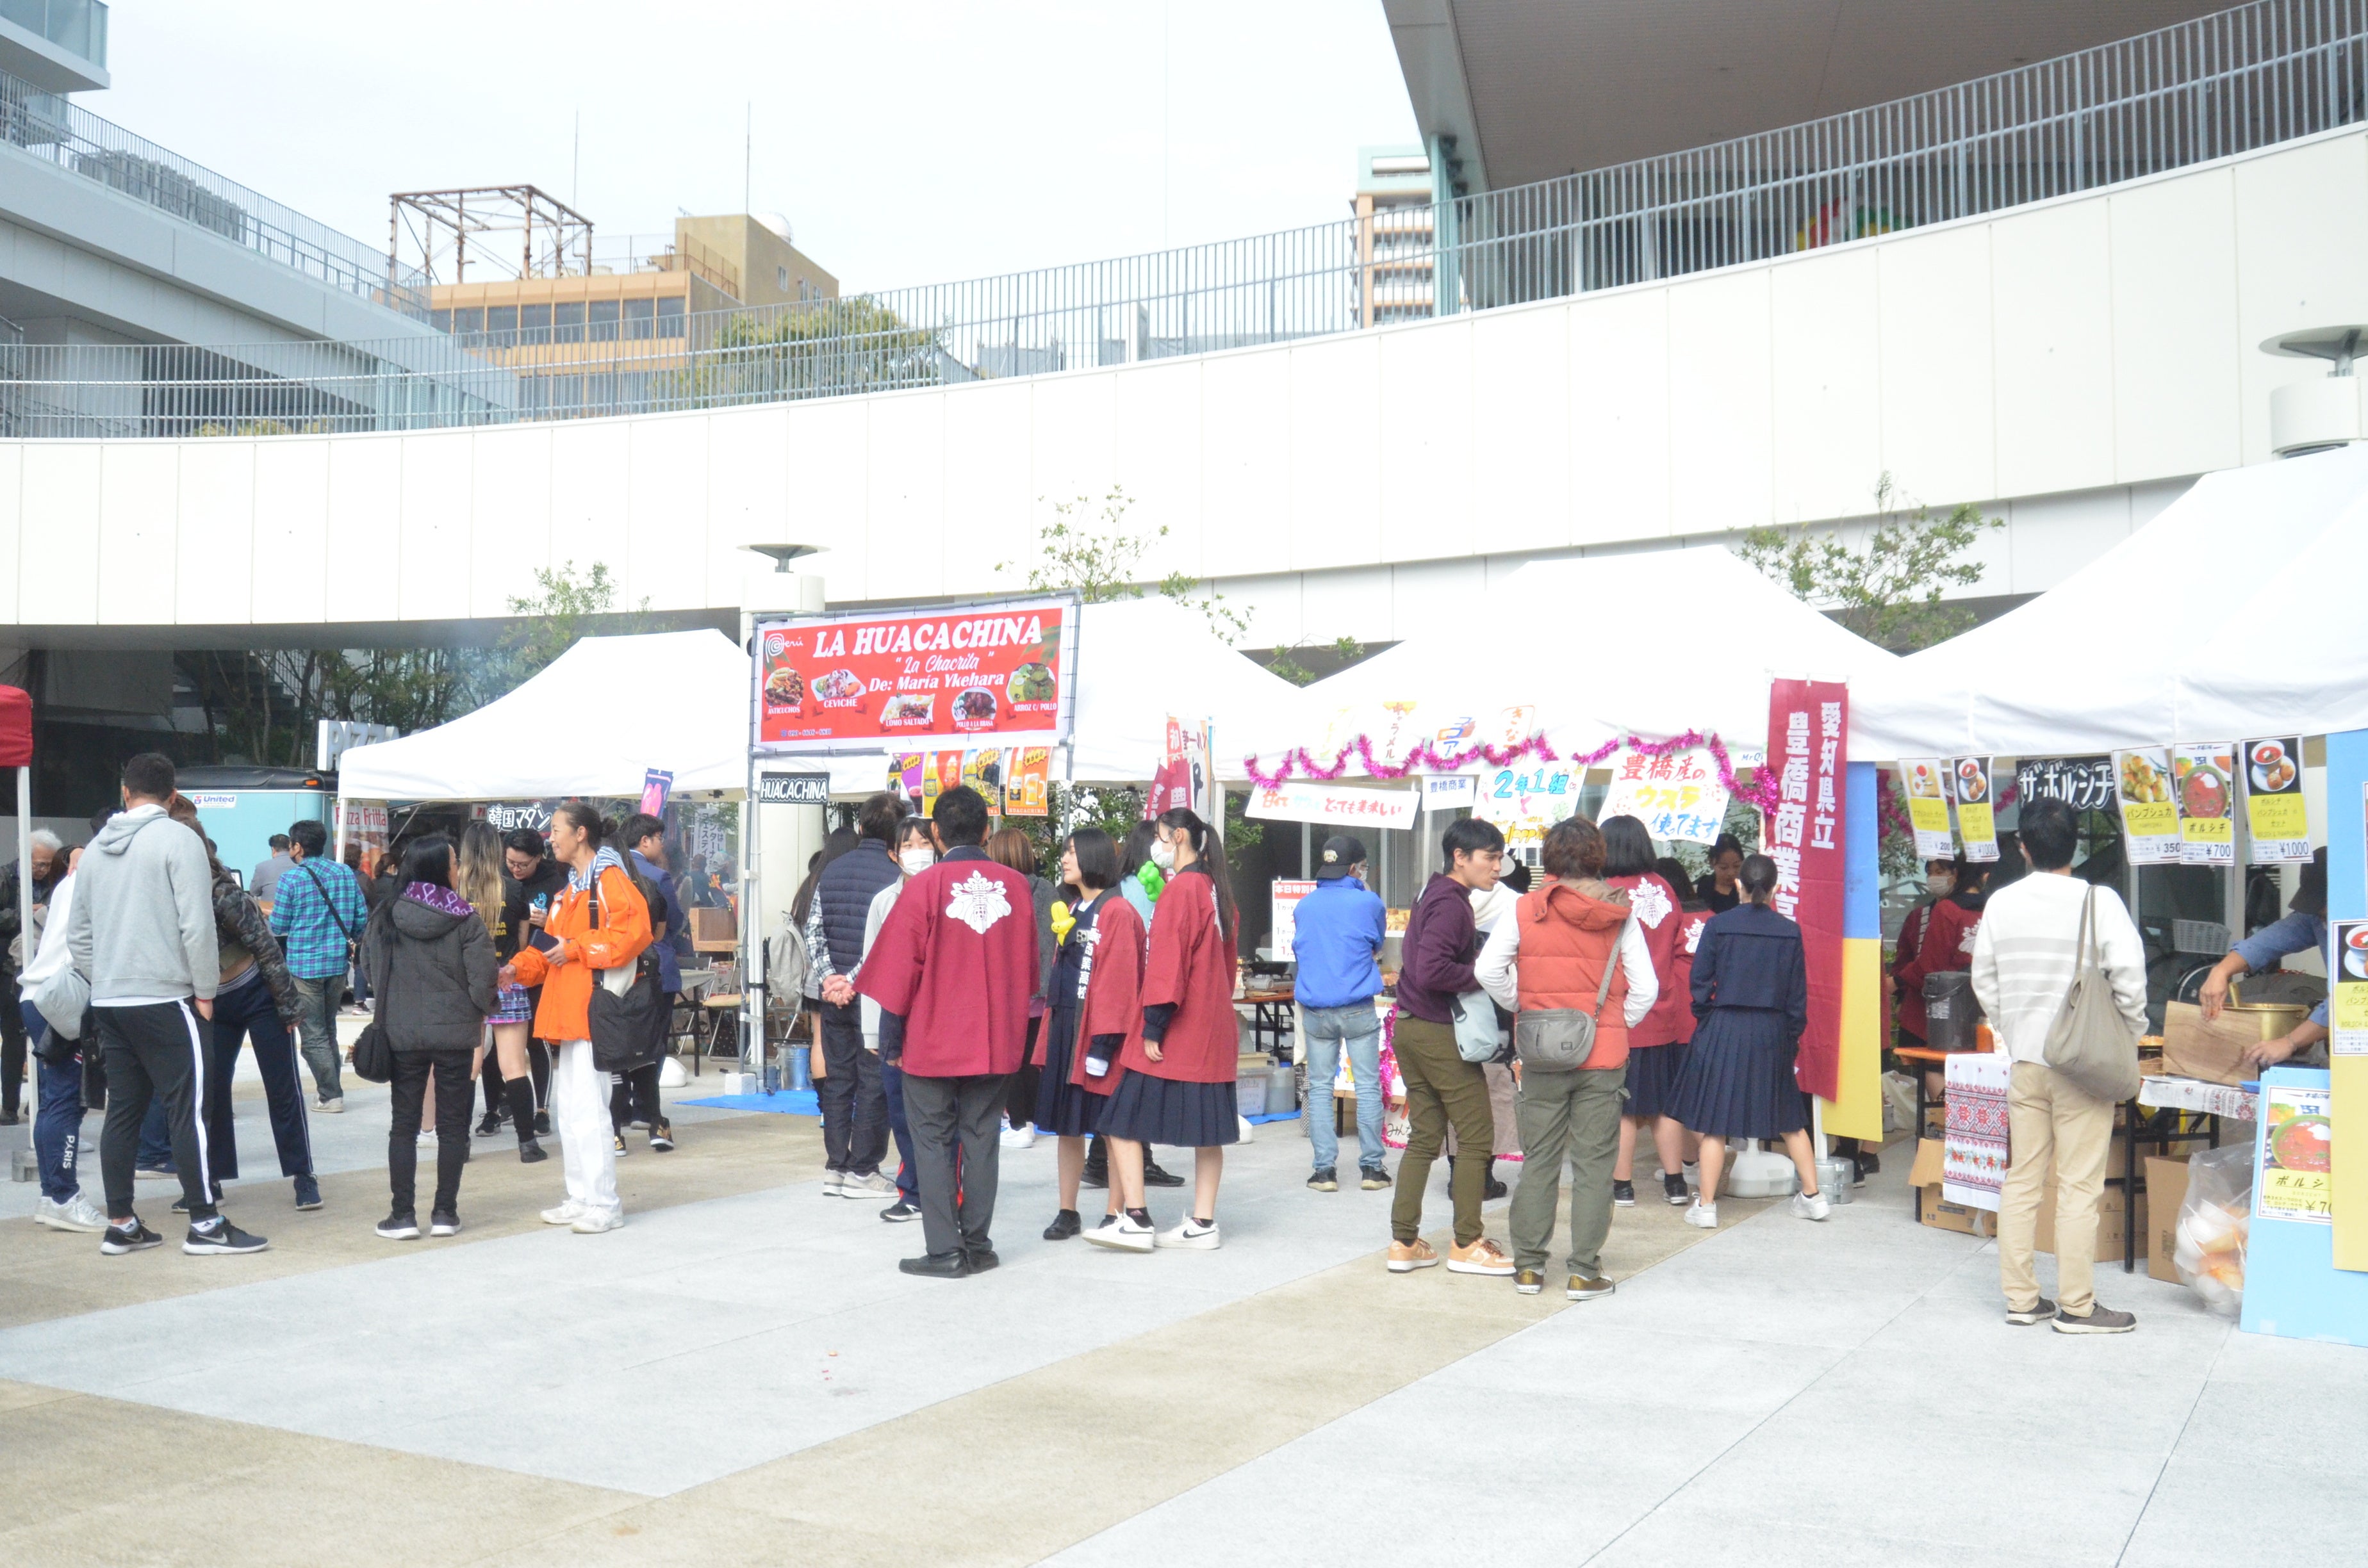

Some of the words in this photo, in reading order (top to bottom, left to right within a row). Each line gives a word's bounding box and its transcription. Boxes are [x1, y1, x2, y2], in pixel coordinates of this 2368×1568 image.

[813, 630, 846, 658] LA
[852, 616, 1042, 655] HUACACHINA
[869, 678, 892, 692] De:
[897, 674, 939, 690] María
[944, 673, 1005, 688] Ykehara
[768, 706, 800, 715] ANTICUCHOS
[824, 698, 858, 708] CEVICHE
[1014, 703, 1032, 712] ARROZ
[1040, 702, 1057, 711] POLLO
[1443, 716, 1472, 757] ココア
[1618, 753, 1707, 782] 豊橋産の
[1811, 701, 1841, 850] 愛知県立
[761, 780, 827, 800] HUACACHINA
[1429, 778, 1467, 794] 豊橋商業
[1493, 768, 1569, 798] 2年1組
[363, 808, 386, 826] Fritta
[488, 803, 550, 830] 韓国マダン
[2127, 808, 2173, 818] パンプシュカ
[1649, 813, 1720, 838] 使ってます
[2189, 822, 2226, 833] ボルシチ
[2164, 842, 2180, 853] 350
[2351, 985, 2368, 993] ボル
[2346, 997, 2368, 1005] パンプ
[63, 1135, 76, 1169] PARIS
[2276, 1175, 2324, 1189] ボルシ
